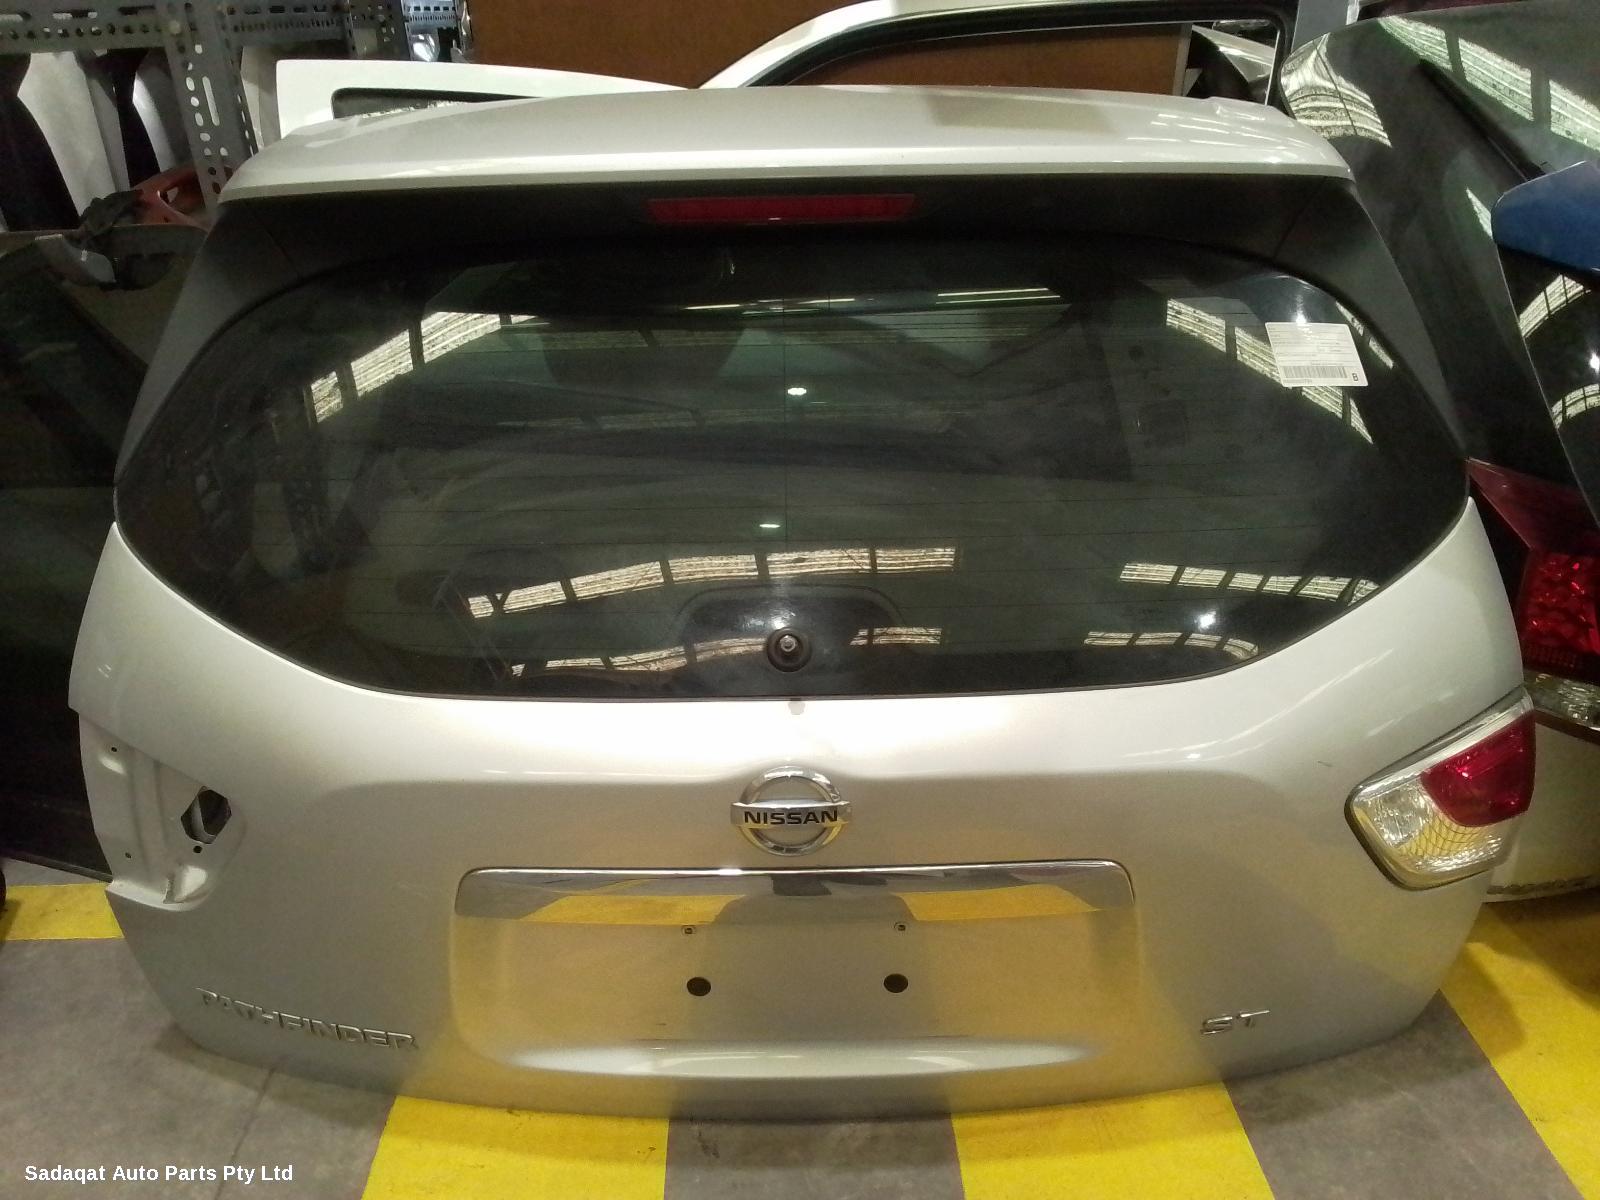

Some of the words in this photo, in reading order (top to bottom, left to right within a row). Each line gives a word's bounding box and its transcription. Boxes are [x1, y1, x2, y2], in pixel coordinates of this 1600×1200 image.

[744, 810, 838, 825] NISSAN
[196, 987, 419, 1050] PATHFINDER
[1200, 1008, 1270, 1036] ST
